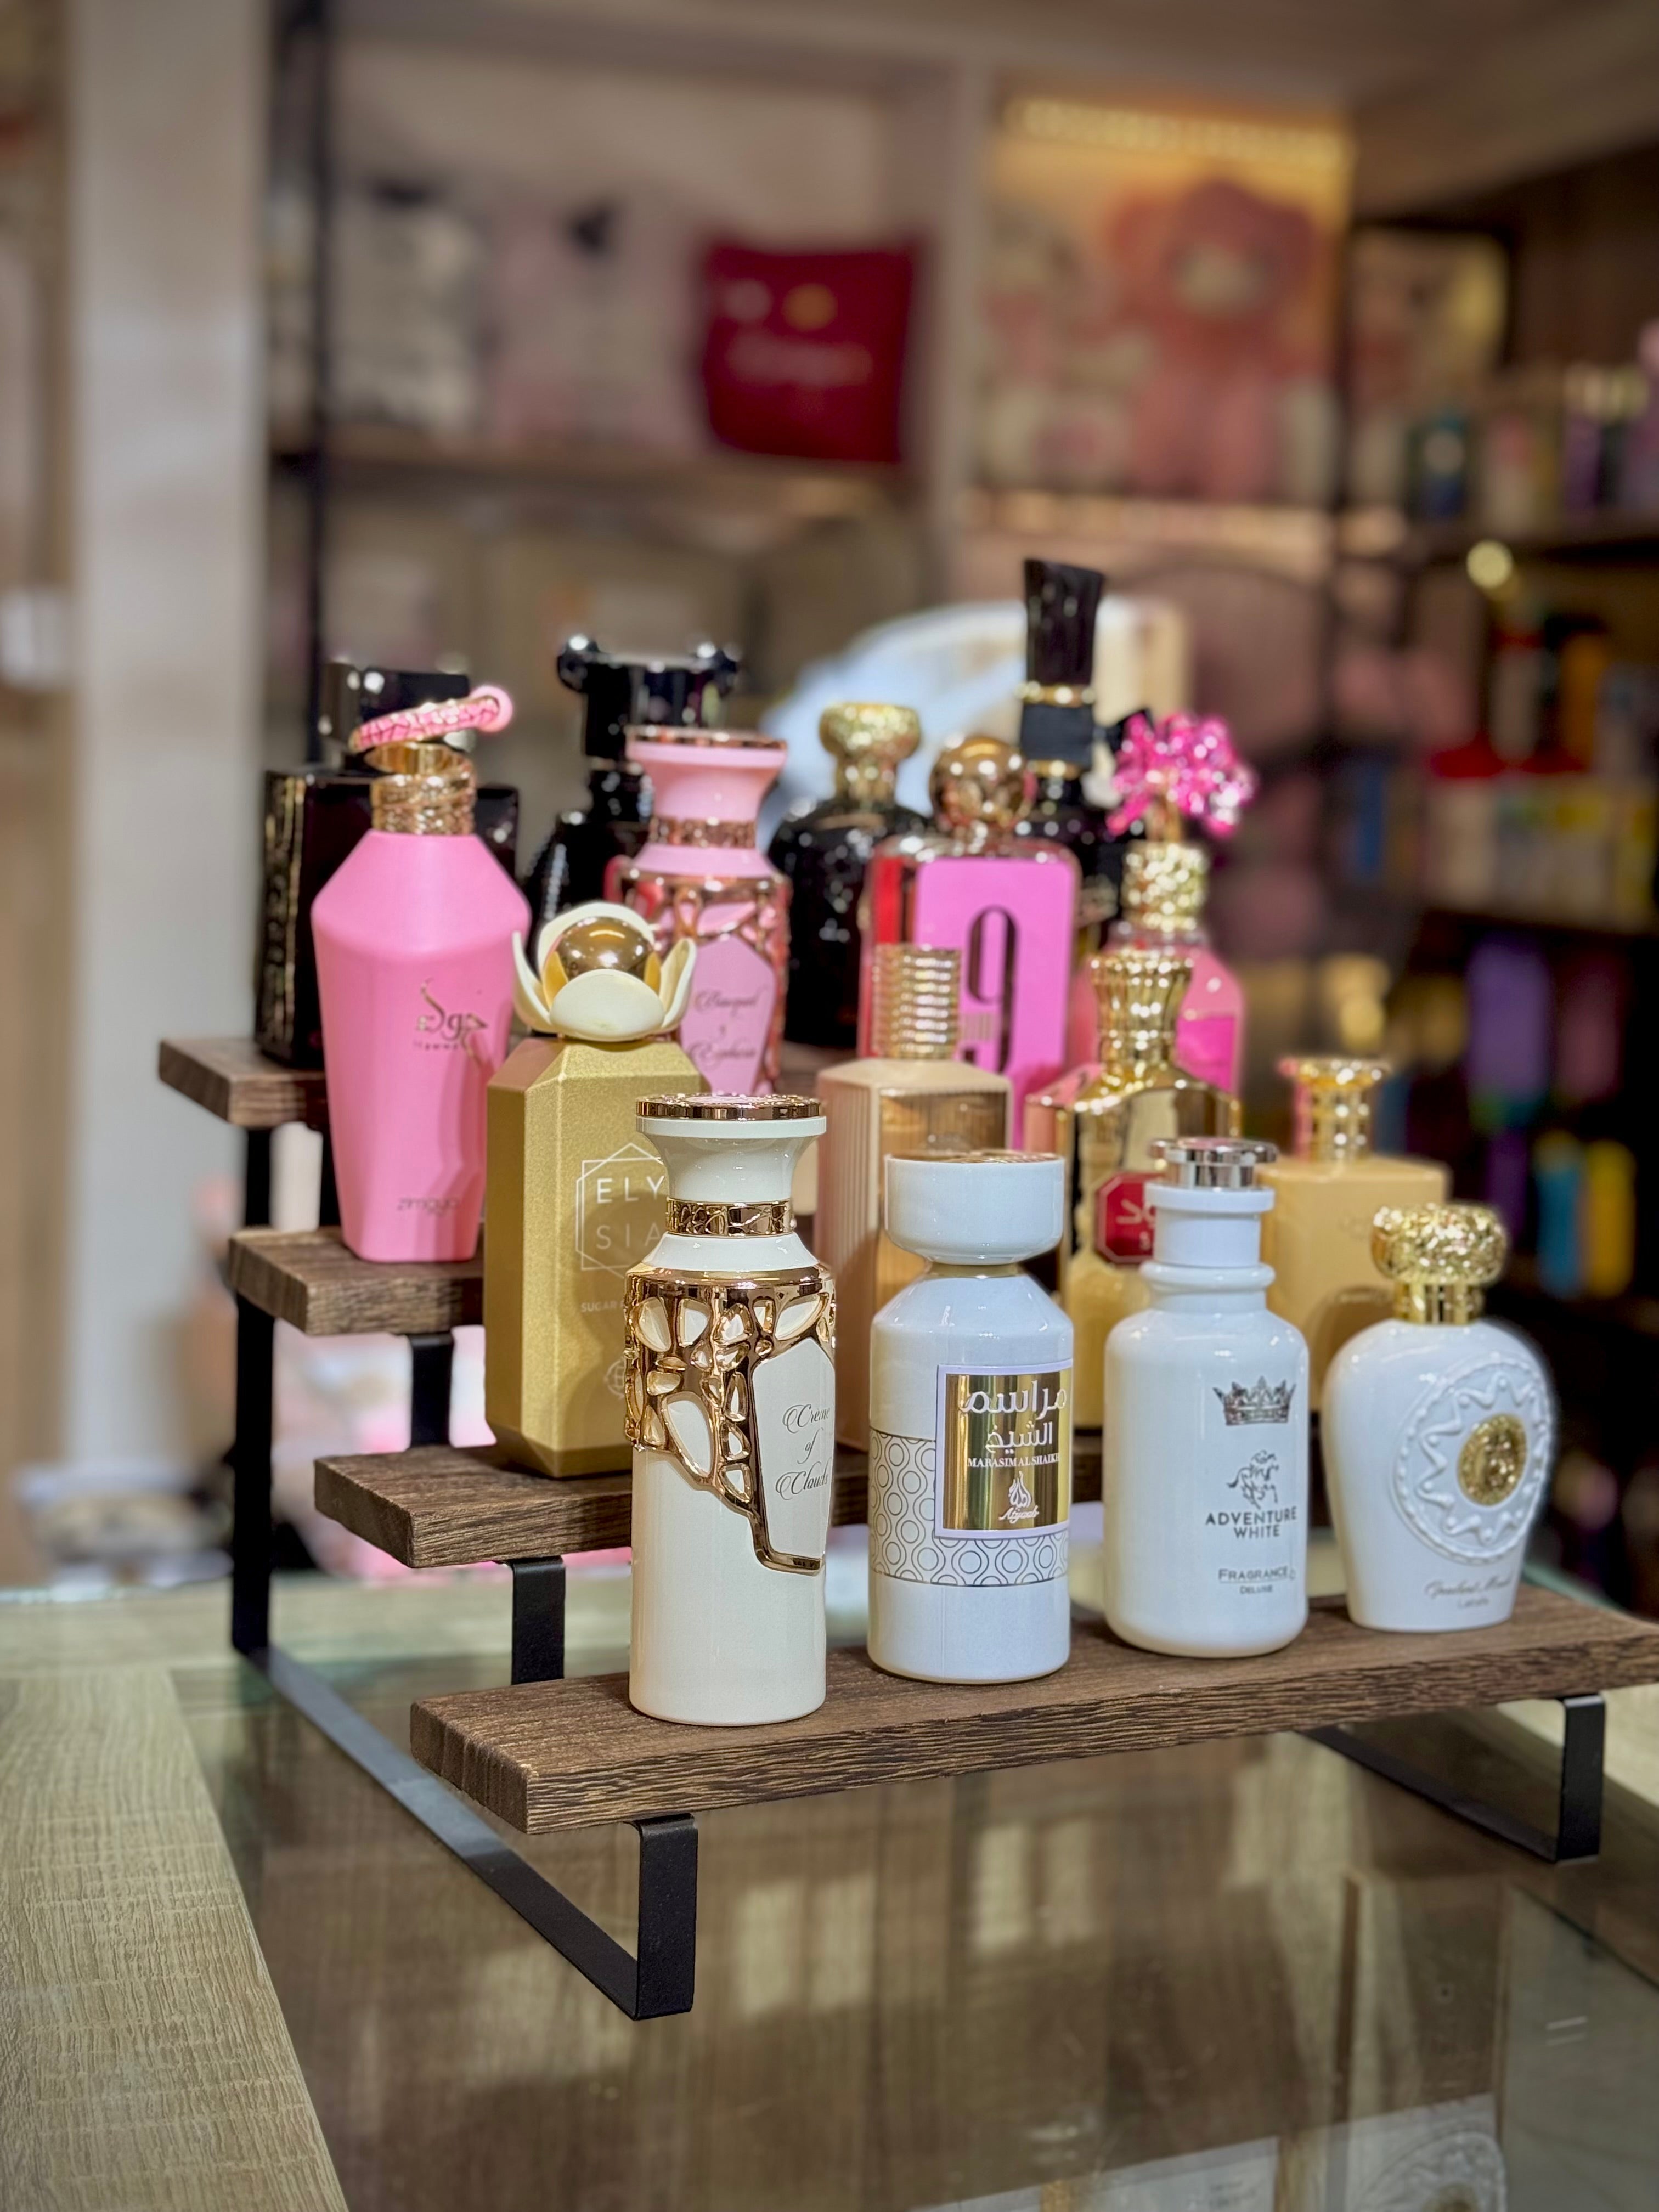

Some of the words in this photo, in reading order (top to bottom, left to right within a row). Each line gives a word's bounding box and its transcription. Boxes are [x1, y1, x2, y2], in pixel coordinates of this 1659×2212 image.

[596, 1176, 664, 1203] ELY
[595, 1222, 662, 1250] SIA
[957, 1380, 1067, 1420] مراسم
[782, 1404, 830, 1434] Crème
[797, 1427, 824, 1465] of
[985, 1420, 1053, 1453] الشيخ
[968, 1457, 1017, 1468] MARASIM
[1018, 1456, 1031, 1467] AL
[775, 1457, 832, 1501] Clouds
[1205, 1505, 1297, 1526] ADVENTURE
[1233, 1525, 1280, 1538] WHITE
[1218, 1566, 1288, 1581] FRAGRANCE
